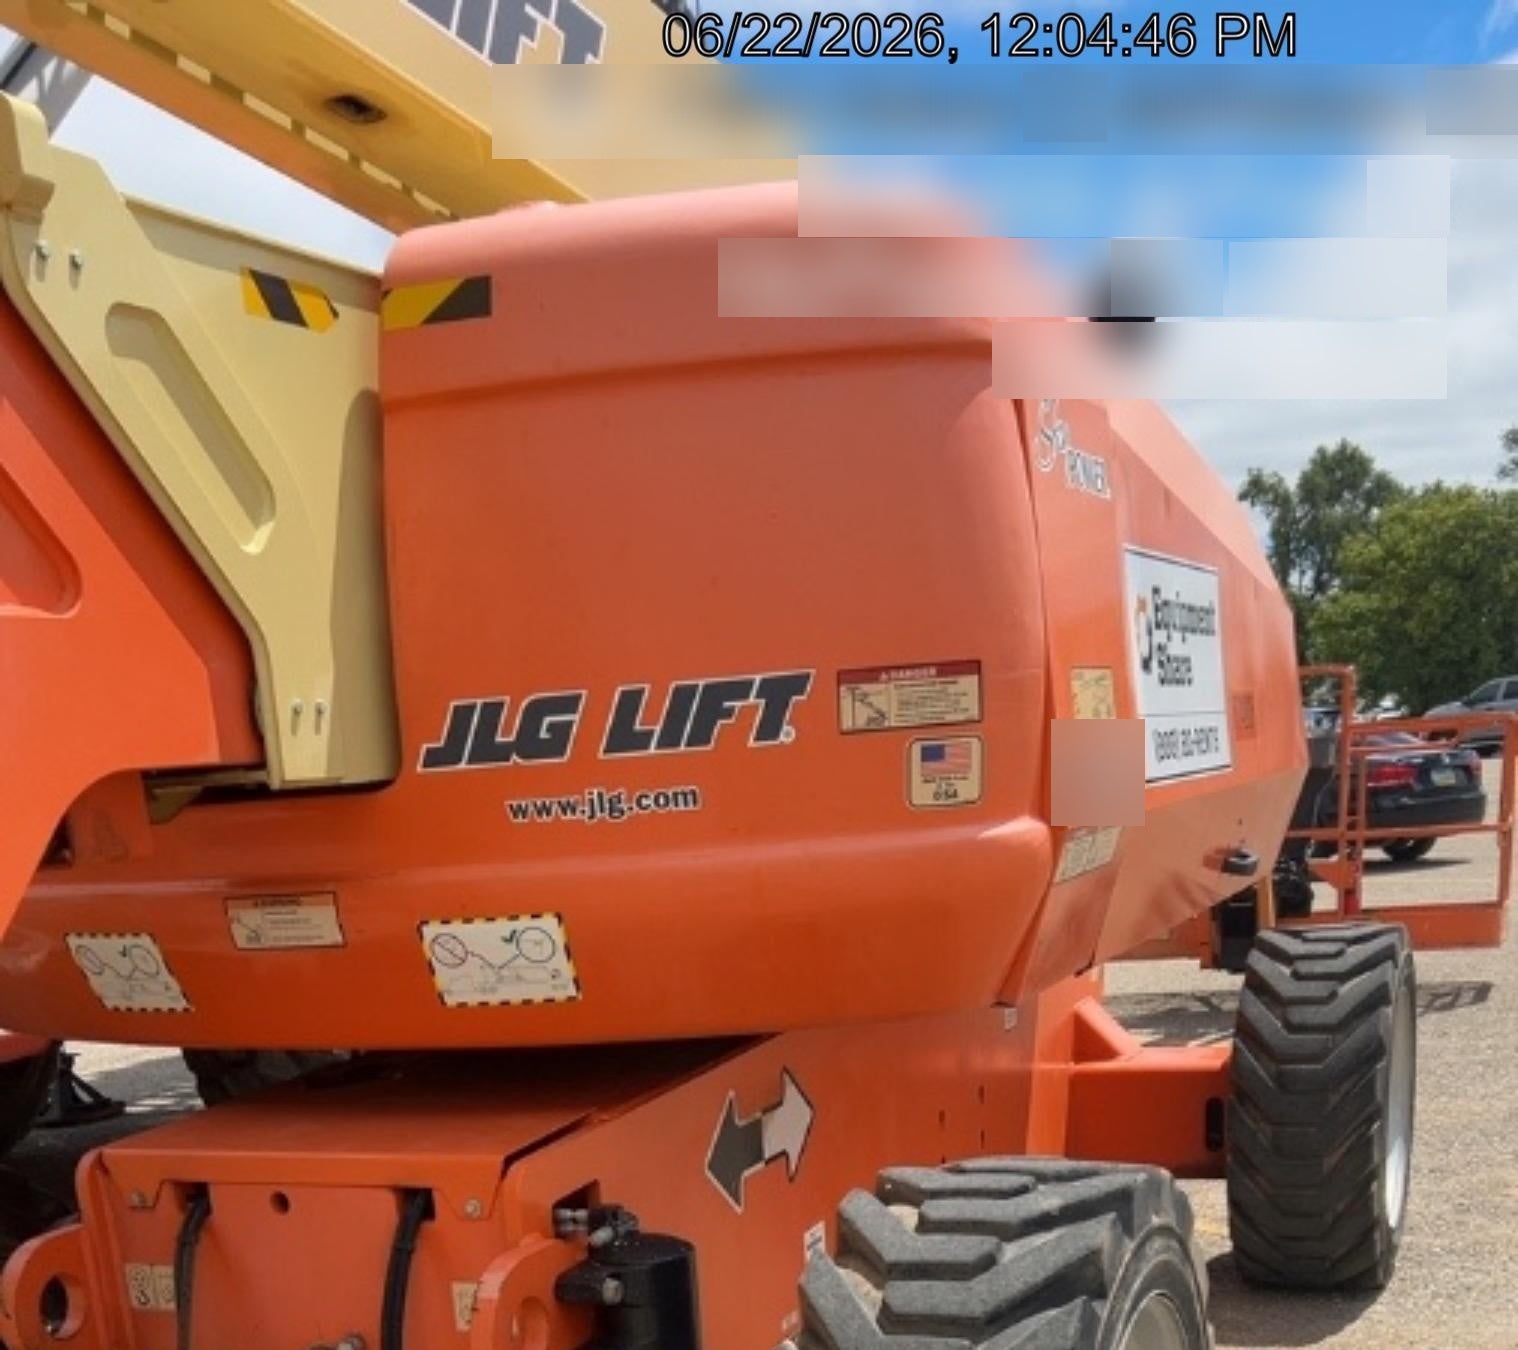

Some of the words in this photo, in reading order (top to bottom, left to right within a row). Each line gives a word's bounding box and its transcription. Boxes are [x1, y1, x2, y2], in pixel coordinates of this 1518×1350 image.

[417, 690, 588, 772] JLG
[598, 669, 816, 760] LIFT
[507, 785, 700, 822] www.jlg.com
